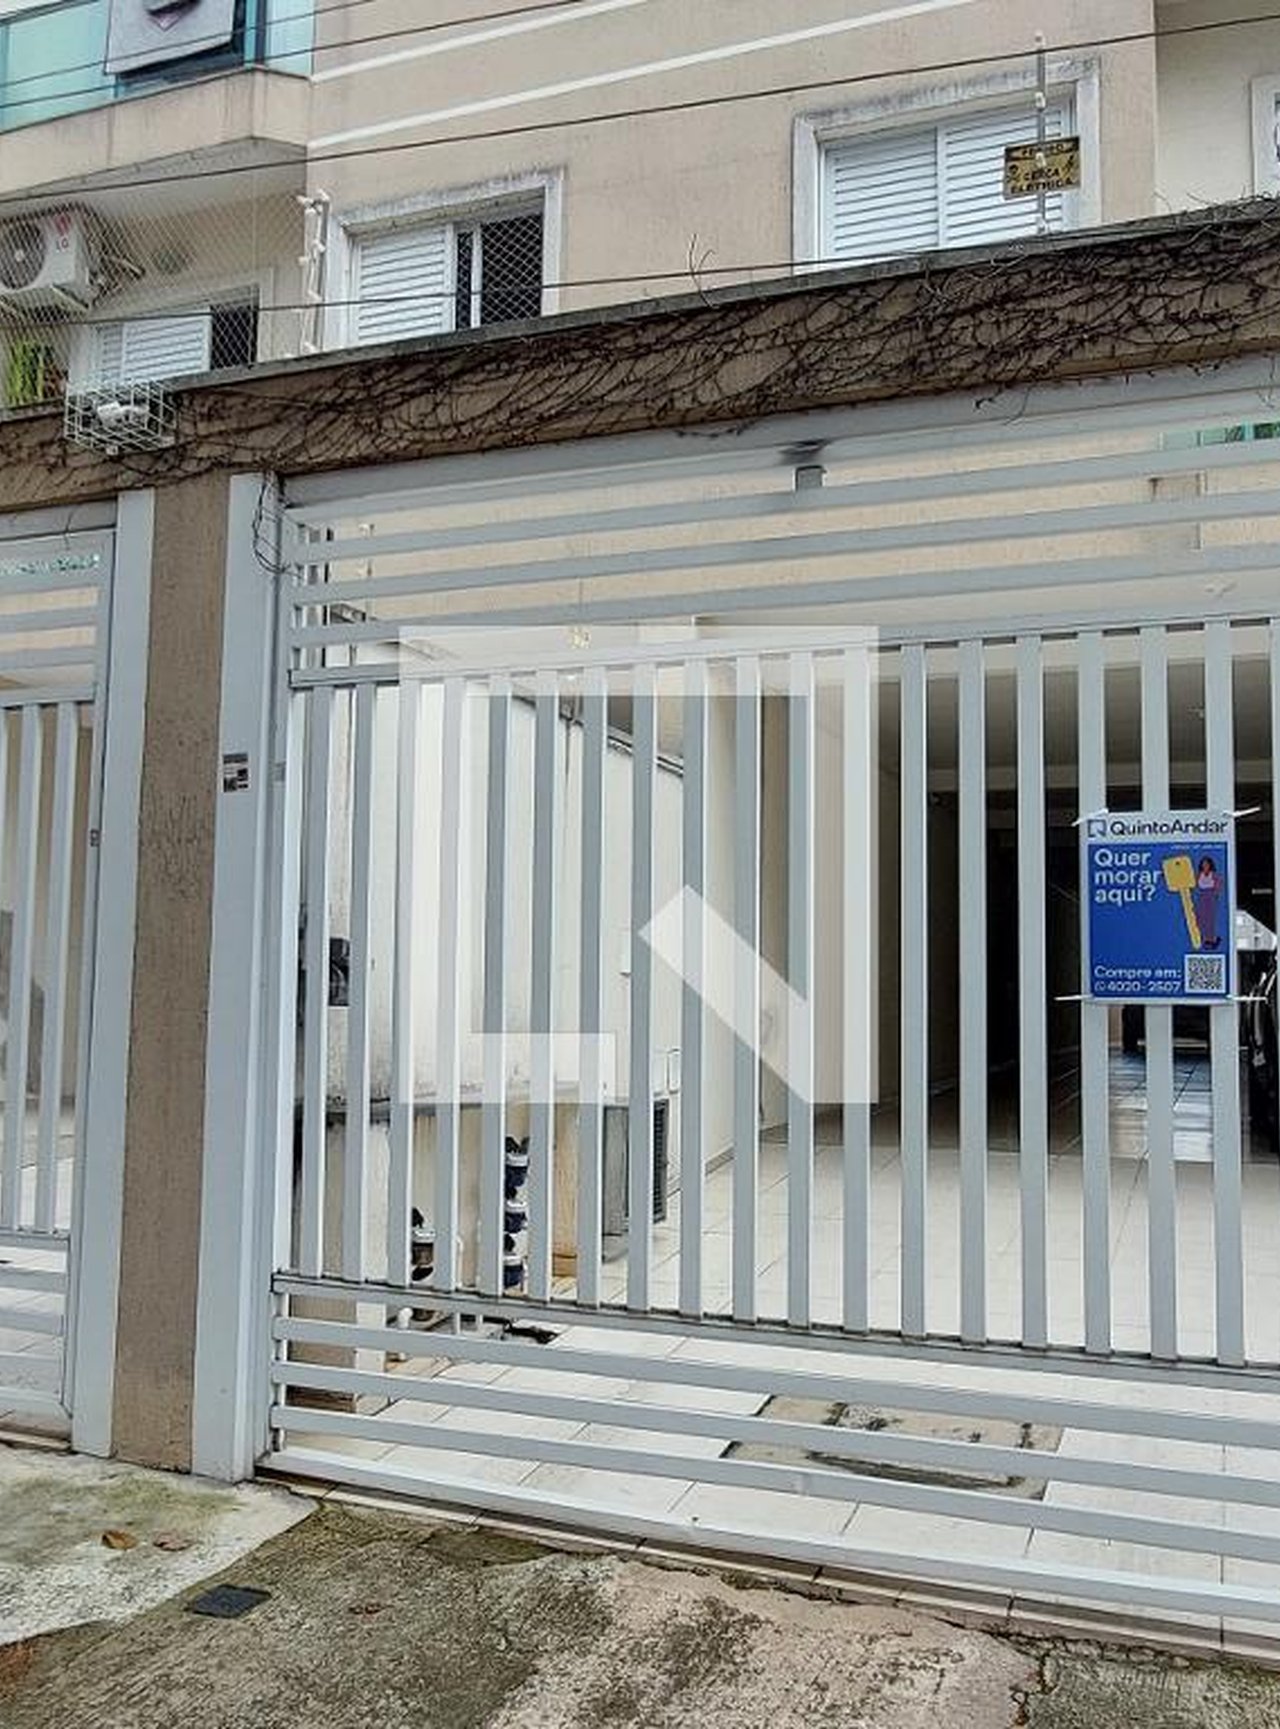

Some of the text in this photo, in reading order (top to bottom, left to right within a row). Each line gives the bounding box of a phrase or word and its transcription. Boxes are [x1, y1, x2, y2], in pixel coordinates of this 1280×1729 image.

[1023, 167, 1060, 181] CERCA
[1109, 819, 1228, 836] QuintoAndar
[1094, 847, 1152, 868] Quer
[1094, 870, 1162, 885] morar
[1094, 884, 1157, 907] aqui?
[1094, 965, 1182, 979] Compre em:
[1107, 980, 1181, 993] 4020-2507
